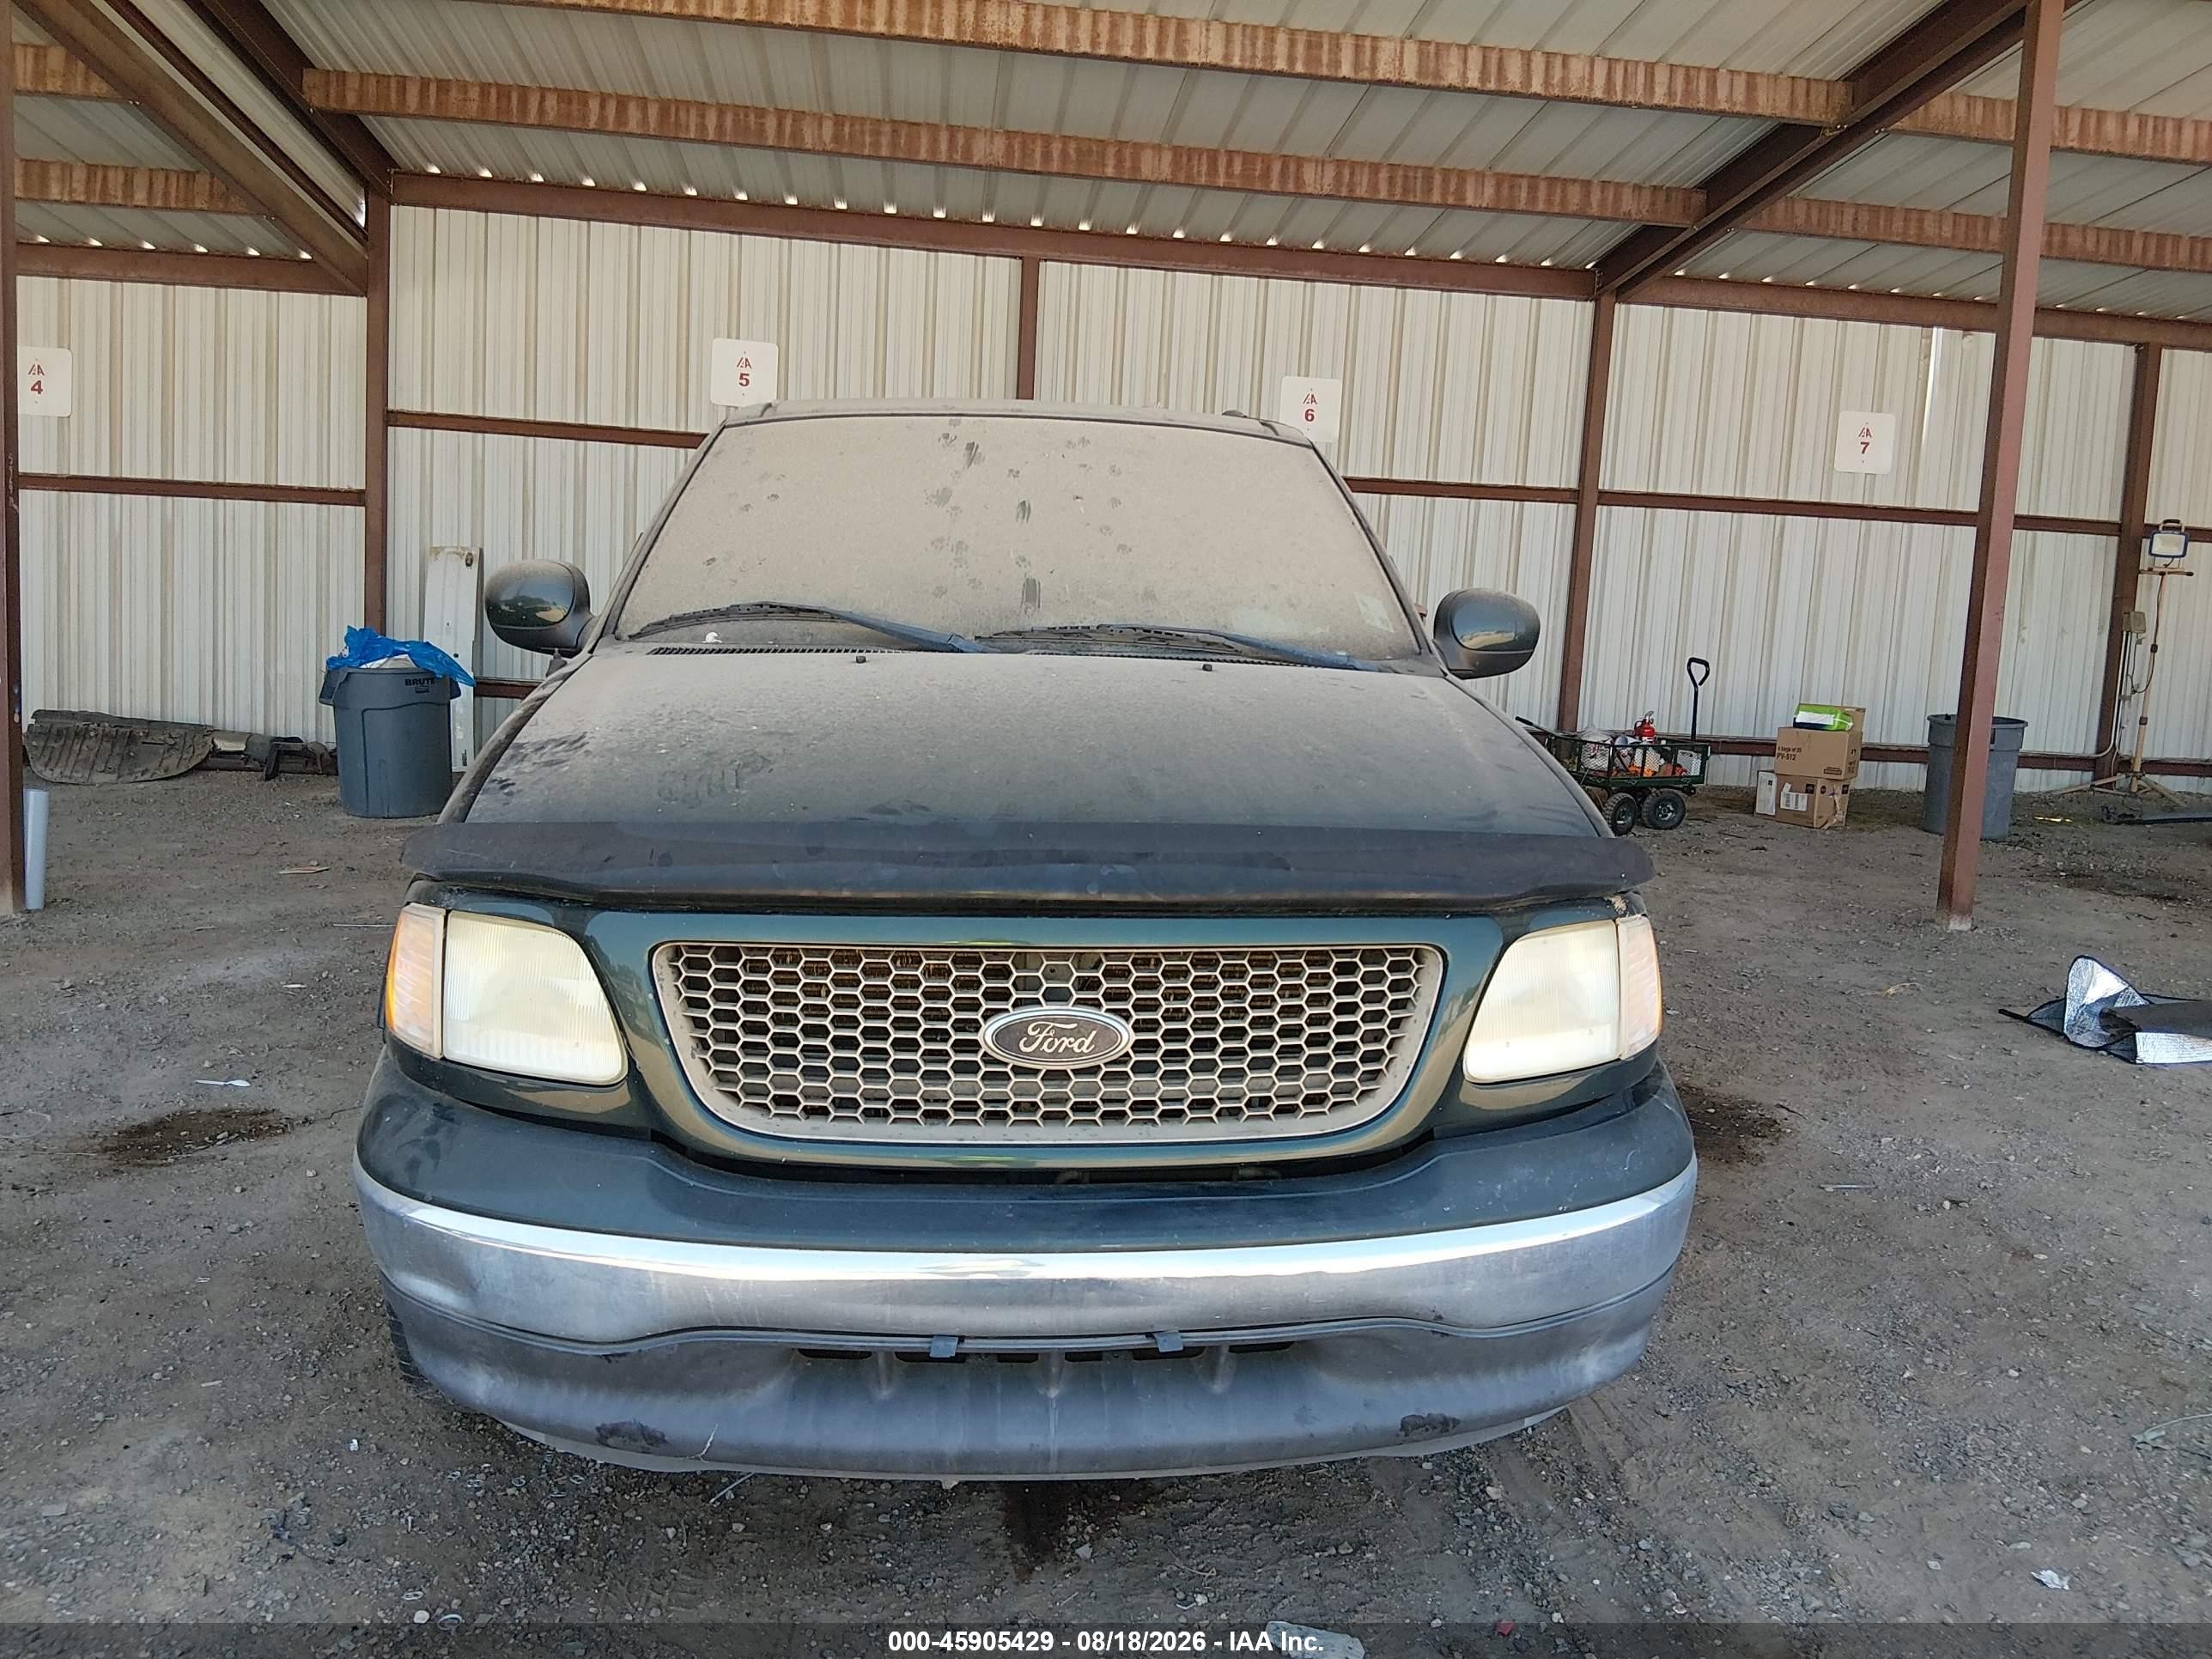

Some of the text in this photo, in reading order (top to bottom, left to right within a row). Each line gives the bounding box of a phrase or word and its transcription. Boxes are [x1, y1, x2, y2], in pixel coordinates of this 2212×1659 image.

[738, 372, 750, 387] 5
[30, 380, 43, 395] 4
[1304, 408, 1316, 422] 6
[1860, 441, 1870, 454] 7
[404, 678, 435, 686] BRUTE
[1018, 1021, 1097, 1054] Ford
